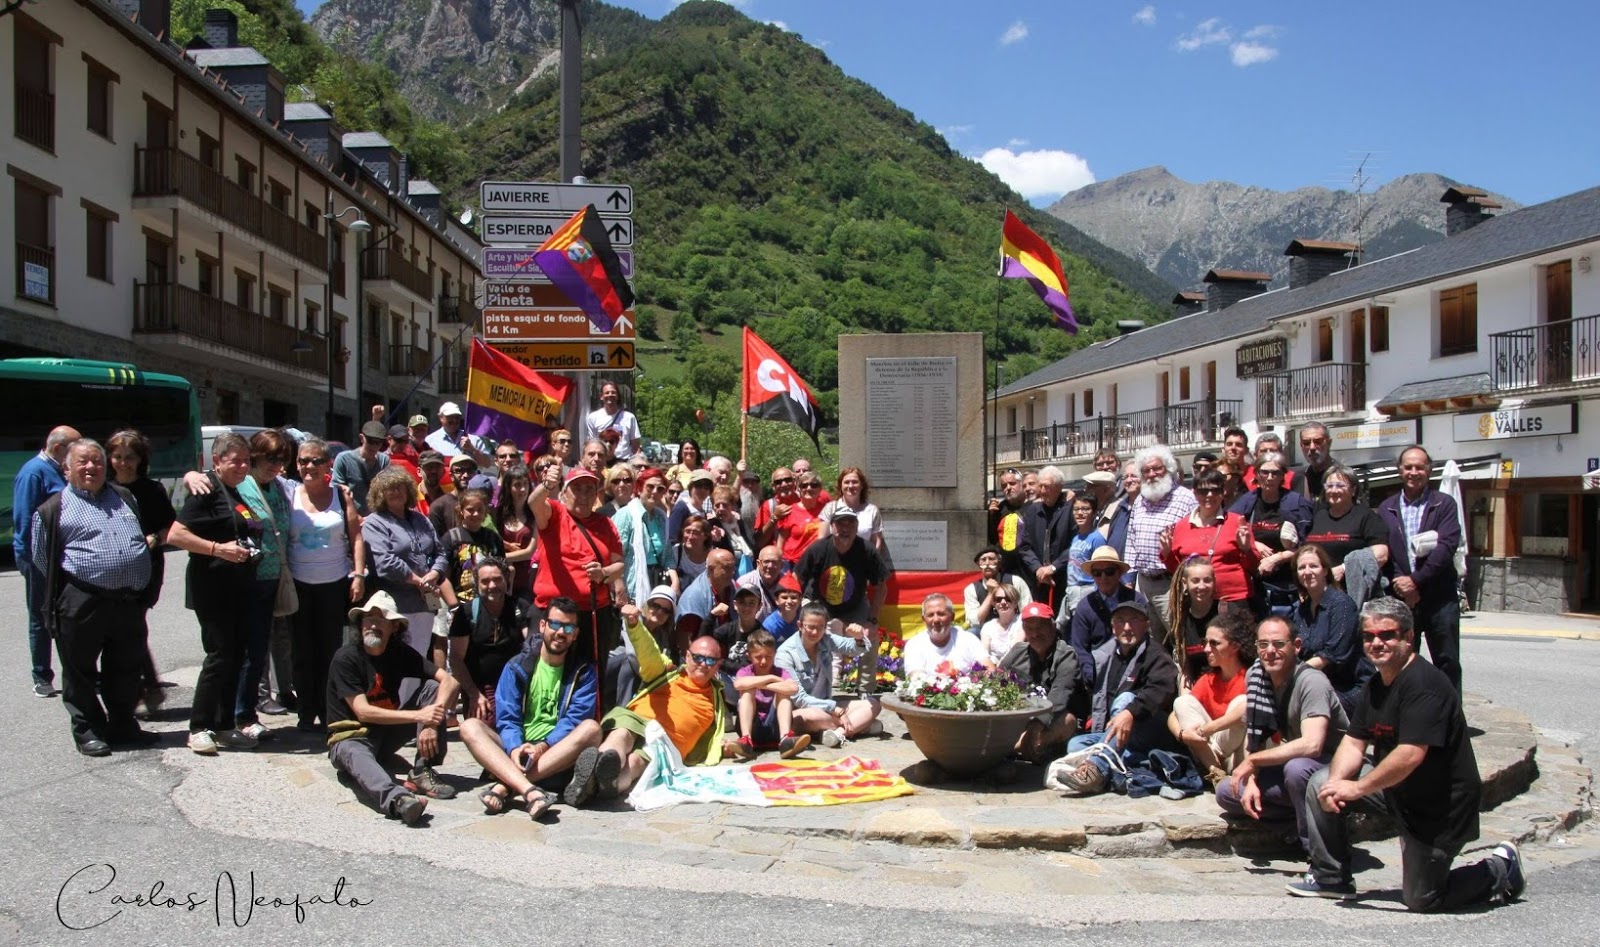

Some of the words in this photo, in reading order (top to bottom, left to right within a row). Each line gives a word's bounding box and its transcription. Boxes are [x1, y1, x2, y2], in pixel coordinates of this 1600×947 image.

[487, 191, 550, 203] JAVIERRE
[487, 224, 553, 236] ESPIERBA
[488, 253, 505, 261] Arte
[507, 255, 512, 263] y
[517, 285, 530, 293] de
[488, 294, 534, 306] Pineta
[486, 314, 510, 323] pista
[514, 314, 540, 323] esquí
[544, 314, 555, 323] de
[559, 314, 586, 323] fondo
[486, 326, 499, 334] 14
[503, 326, 519, 334] Km
[1238, 341, 1282, 365] HABITACIONES
[534, 355, 582, 366] Perdido
[489, 384, 526, 410] MEMORIA
[528, 396, 535, 412] Y
[1495, 412, 1508, 420] LOS
[1495, 416, 1543, 434] VALLES
[1590, 459, 1596, 468] R
